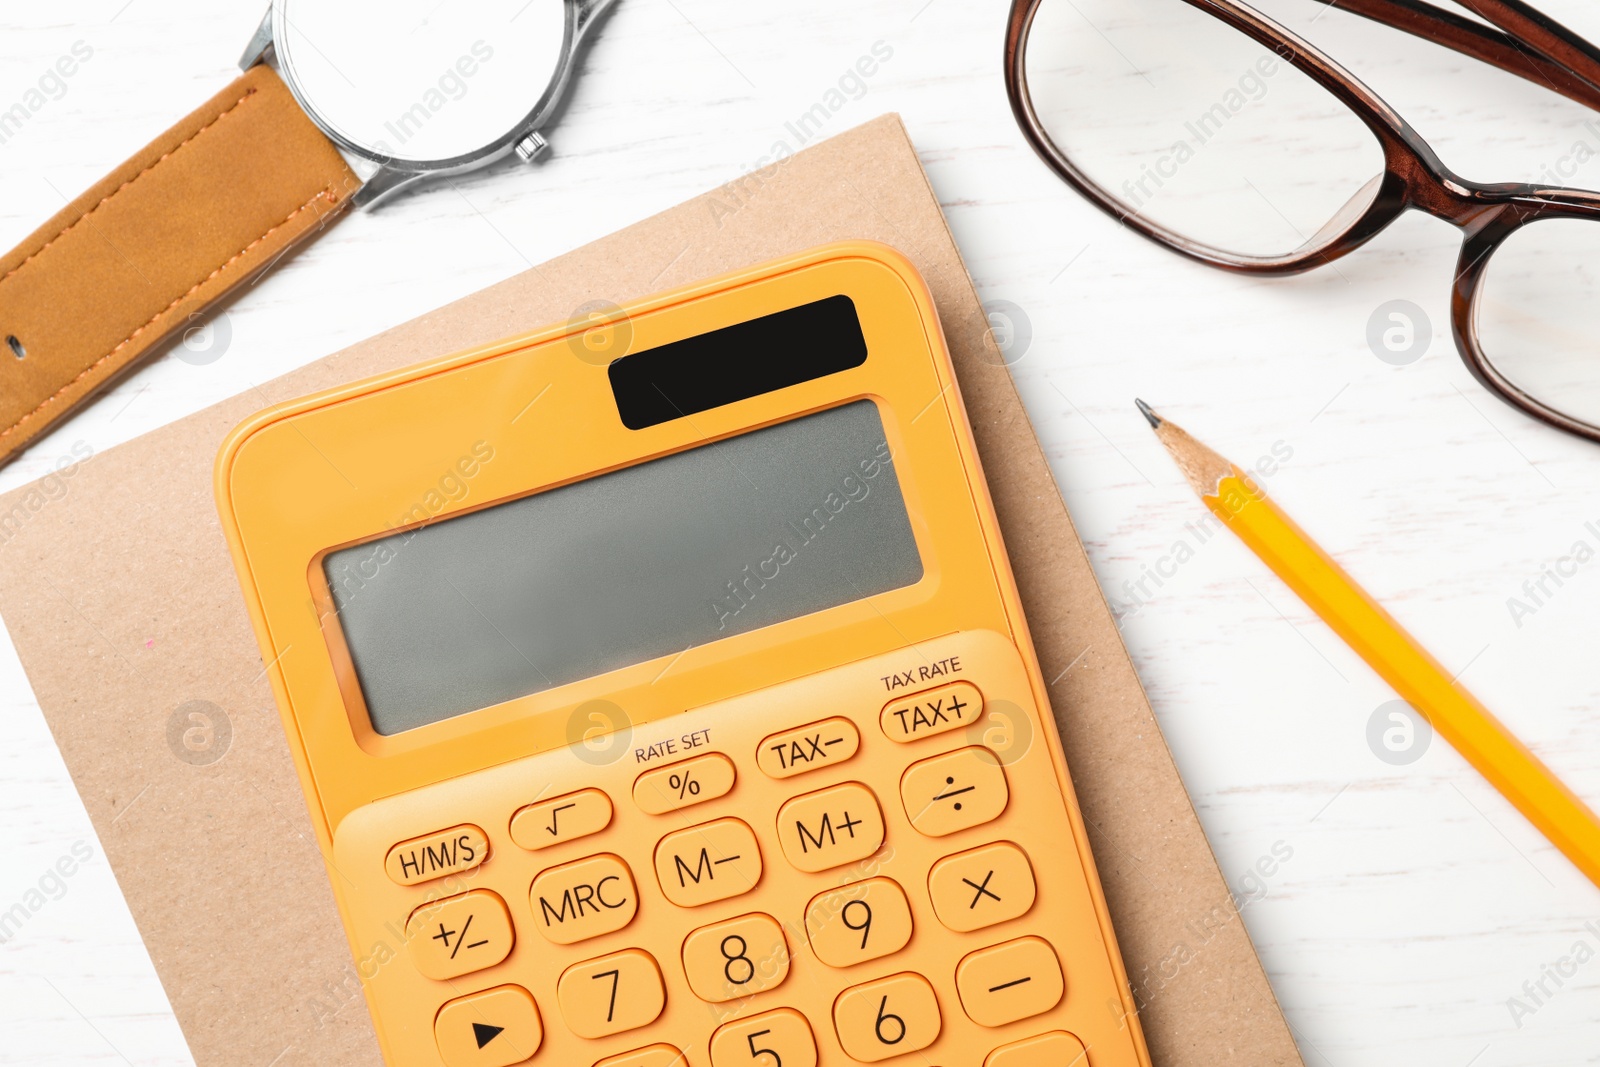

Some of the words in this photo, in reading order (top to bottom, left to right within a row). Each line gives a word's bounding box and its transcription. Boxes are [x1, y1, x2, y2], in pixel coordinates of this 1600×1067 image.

[880, 671, 917, 692] TAX
[918, 656, 963, 682] RATE
[893, 694, 968, 734] TAX+
[635, 740, 677, 765] RATE
[680, 729, 711, 751] SET
[669, 770, 701, 800] %
[796, 811, 863, 854] M+
[399, 835, 475, 879] H/M/S
[538, 875, 627, 928] MRC
[841, 899, 872, 950] 9
[720, 934, 755, 985] 8
[591, 969, 619, 1023] 7
[875, 995, 906, 1045] 6
[747, 1029, 782, 1067] 5
